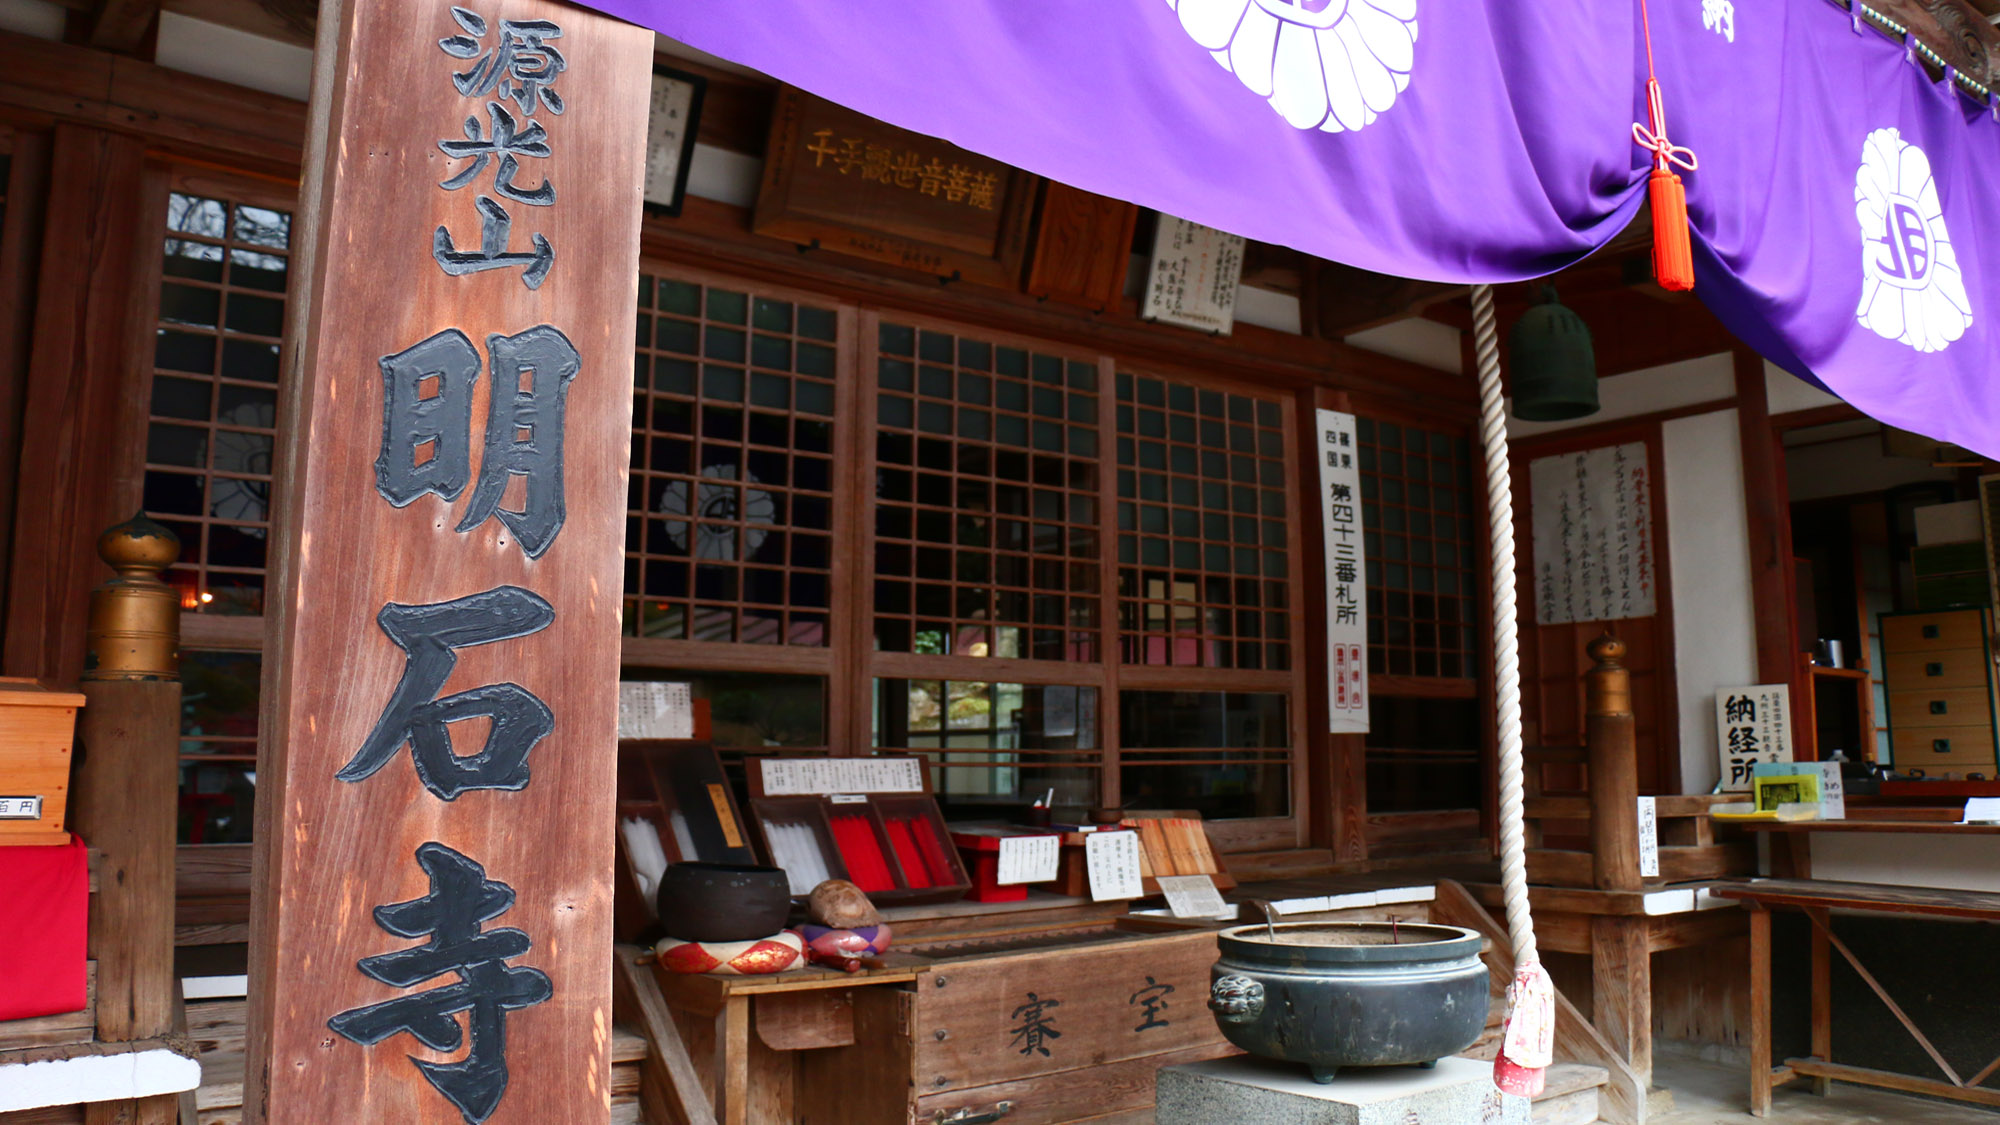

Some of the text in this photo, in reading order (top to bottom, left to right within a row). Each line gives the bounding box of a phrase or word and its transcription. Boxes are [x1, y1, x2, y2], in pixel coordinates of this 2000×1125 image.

[1326, 430, 1338, 467] 四国
[327, 5, 582, 1124] 源光山 明石寺
[1331, 483, 1358, 626] 第四十三番札所
[1725, 694, 1760, 785] 納経所
